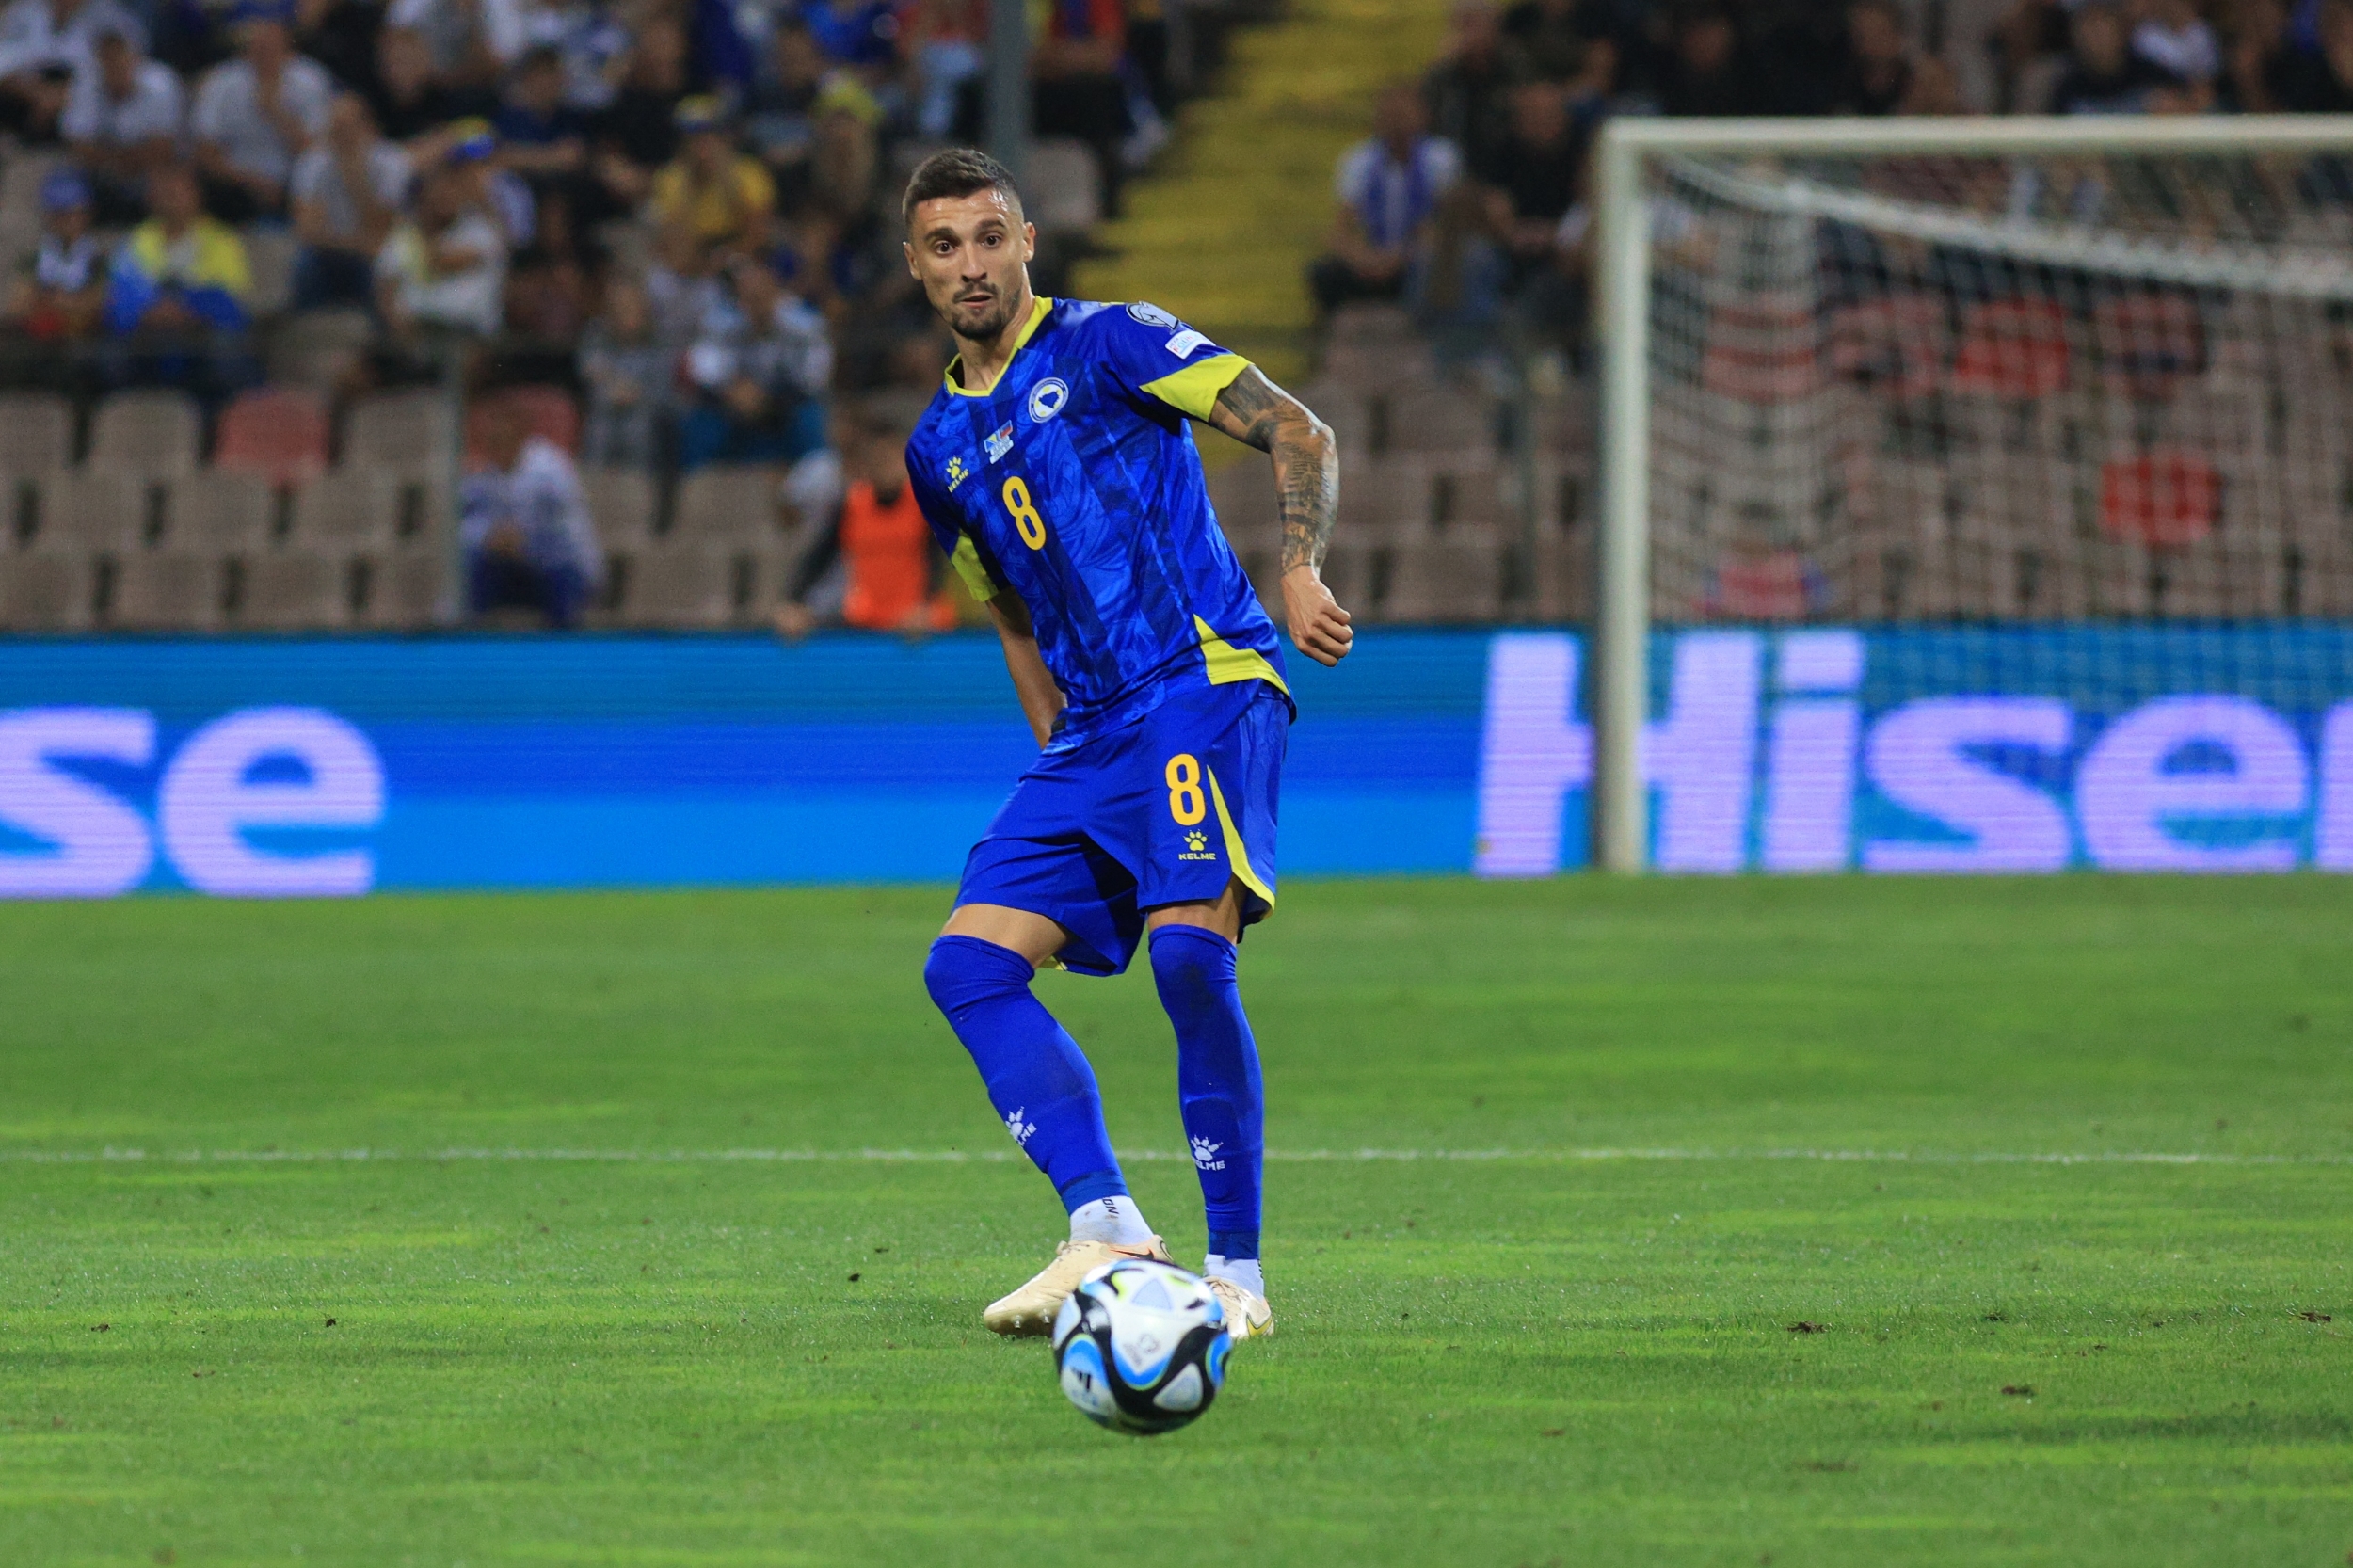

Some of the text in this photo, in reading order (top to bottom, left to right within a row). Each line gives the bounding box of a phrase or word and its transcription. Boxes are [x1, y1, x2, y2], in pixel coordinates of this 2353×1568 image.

[947, 468, 969, 493] KELME
[1002, 475, 1047, 551] 8
[1165, 753, 1207, 826] 8
[1474, 630, 2353, 878] Hise
[1178, 852, 1216, 861] KELME
